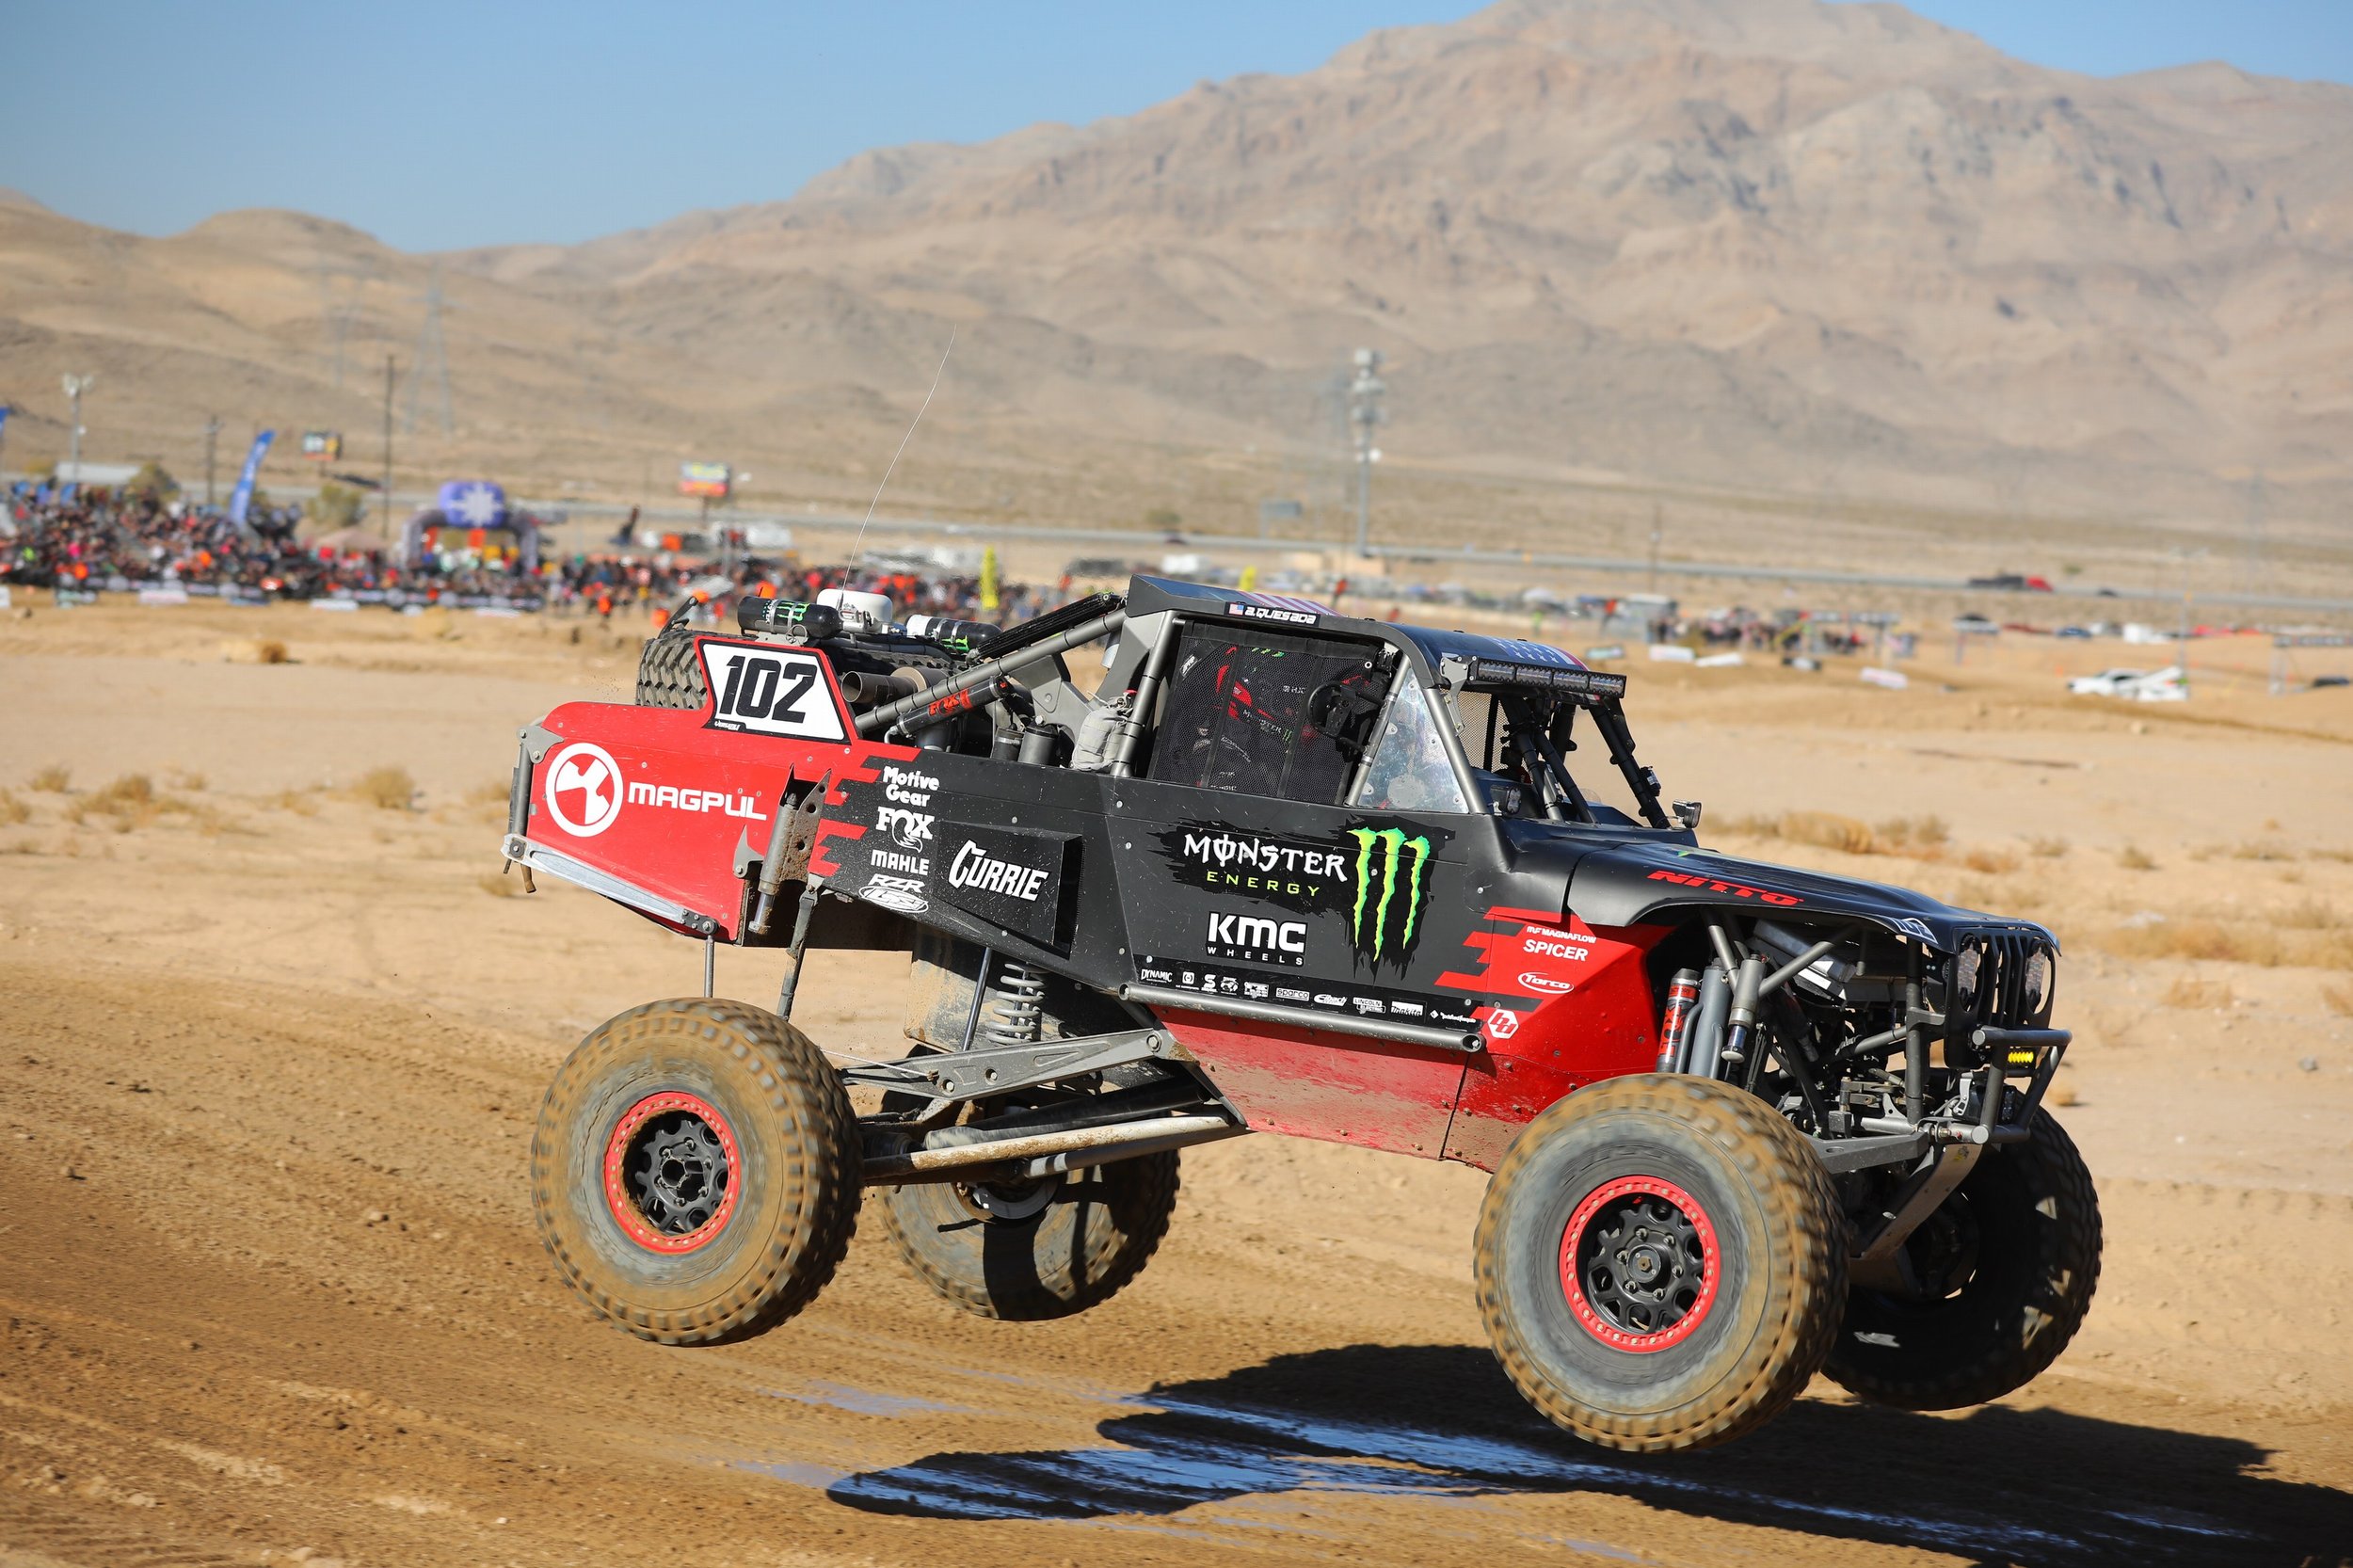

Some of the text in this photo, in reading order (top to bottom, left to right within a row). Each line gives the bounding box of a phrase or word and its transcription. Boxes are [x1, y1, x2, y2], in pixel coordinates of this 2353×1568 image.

[720, 655, 816, 724] 102
[883, 765, 940, 791] Motive
[628, 782, 767, 820] MAGPUL
[886, 784, 930, 807] Gear
[875, 807, 935, 853] FOX
[871, 849, 930, 876] MAHLE
[949, 840, 1048, 901] CURRIE
[1183, 833, 1348, 882] MONSTER
[868, 873, 925, 893] RZR
[1207, 871, 1320, 897] ENERGY
[1647, 870, 1799, 906] NITTO
[1208, 912, 1306, 953] KMC
[1542, 928, 1597, 944] MAGNAFLOW
[1208, 947, 1304, 966] WHEELS
[1523, 939, 1589, 961] SPICER
[1141, 968, 1173, 983] DYNAMIC
[1525, 973, 1570, 989] Torco
[1277, 988, 1309, 999] sparco
[1354, 999, 1381, 1007] LINCOLN
